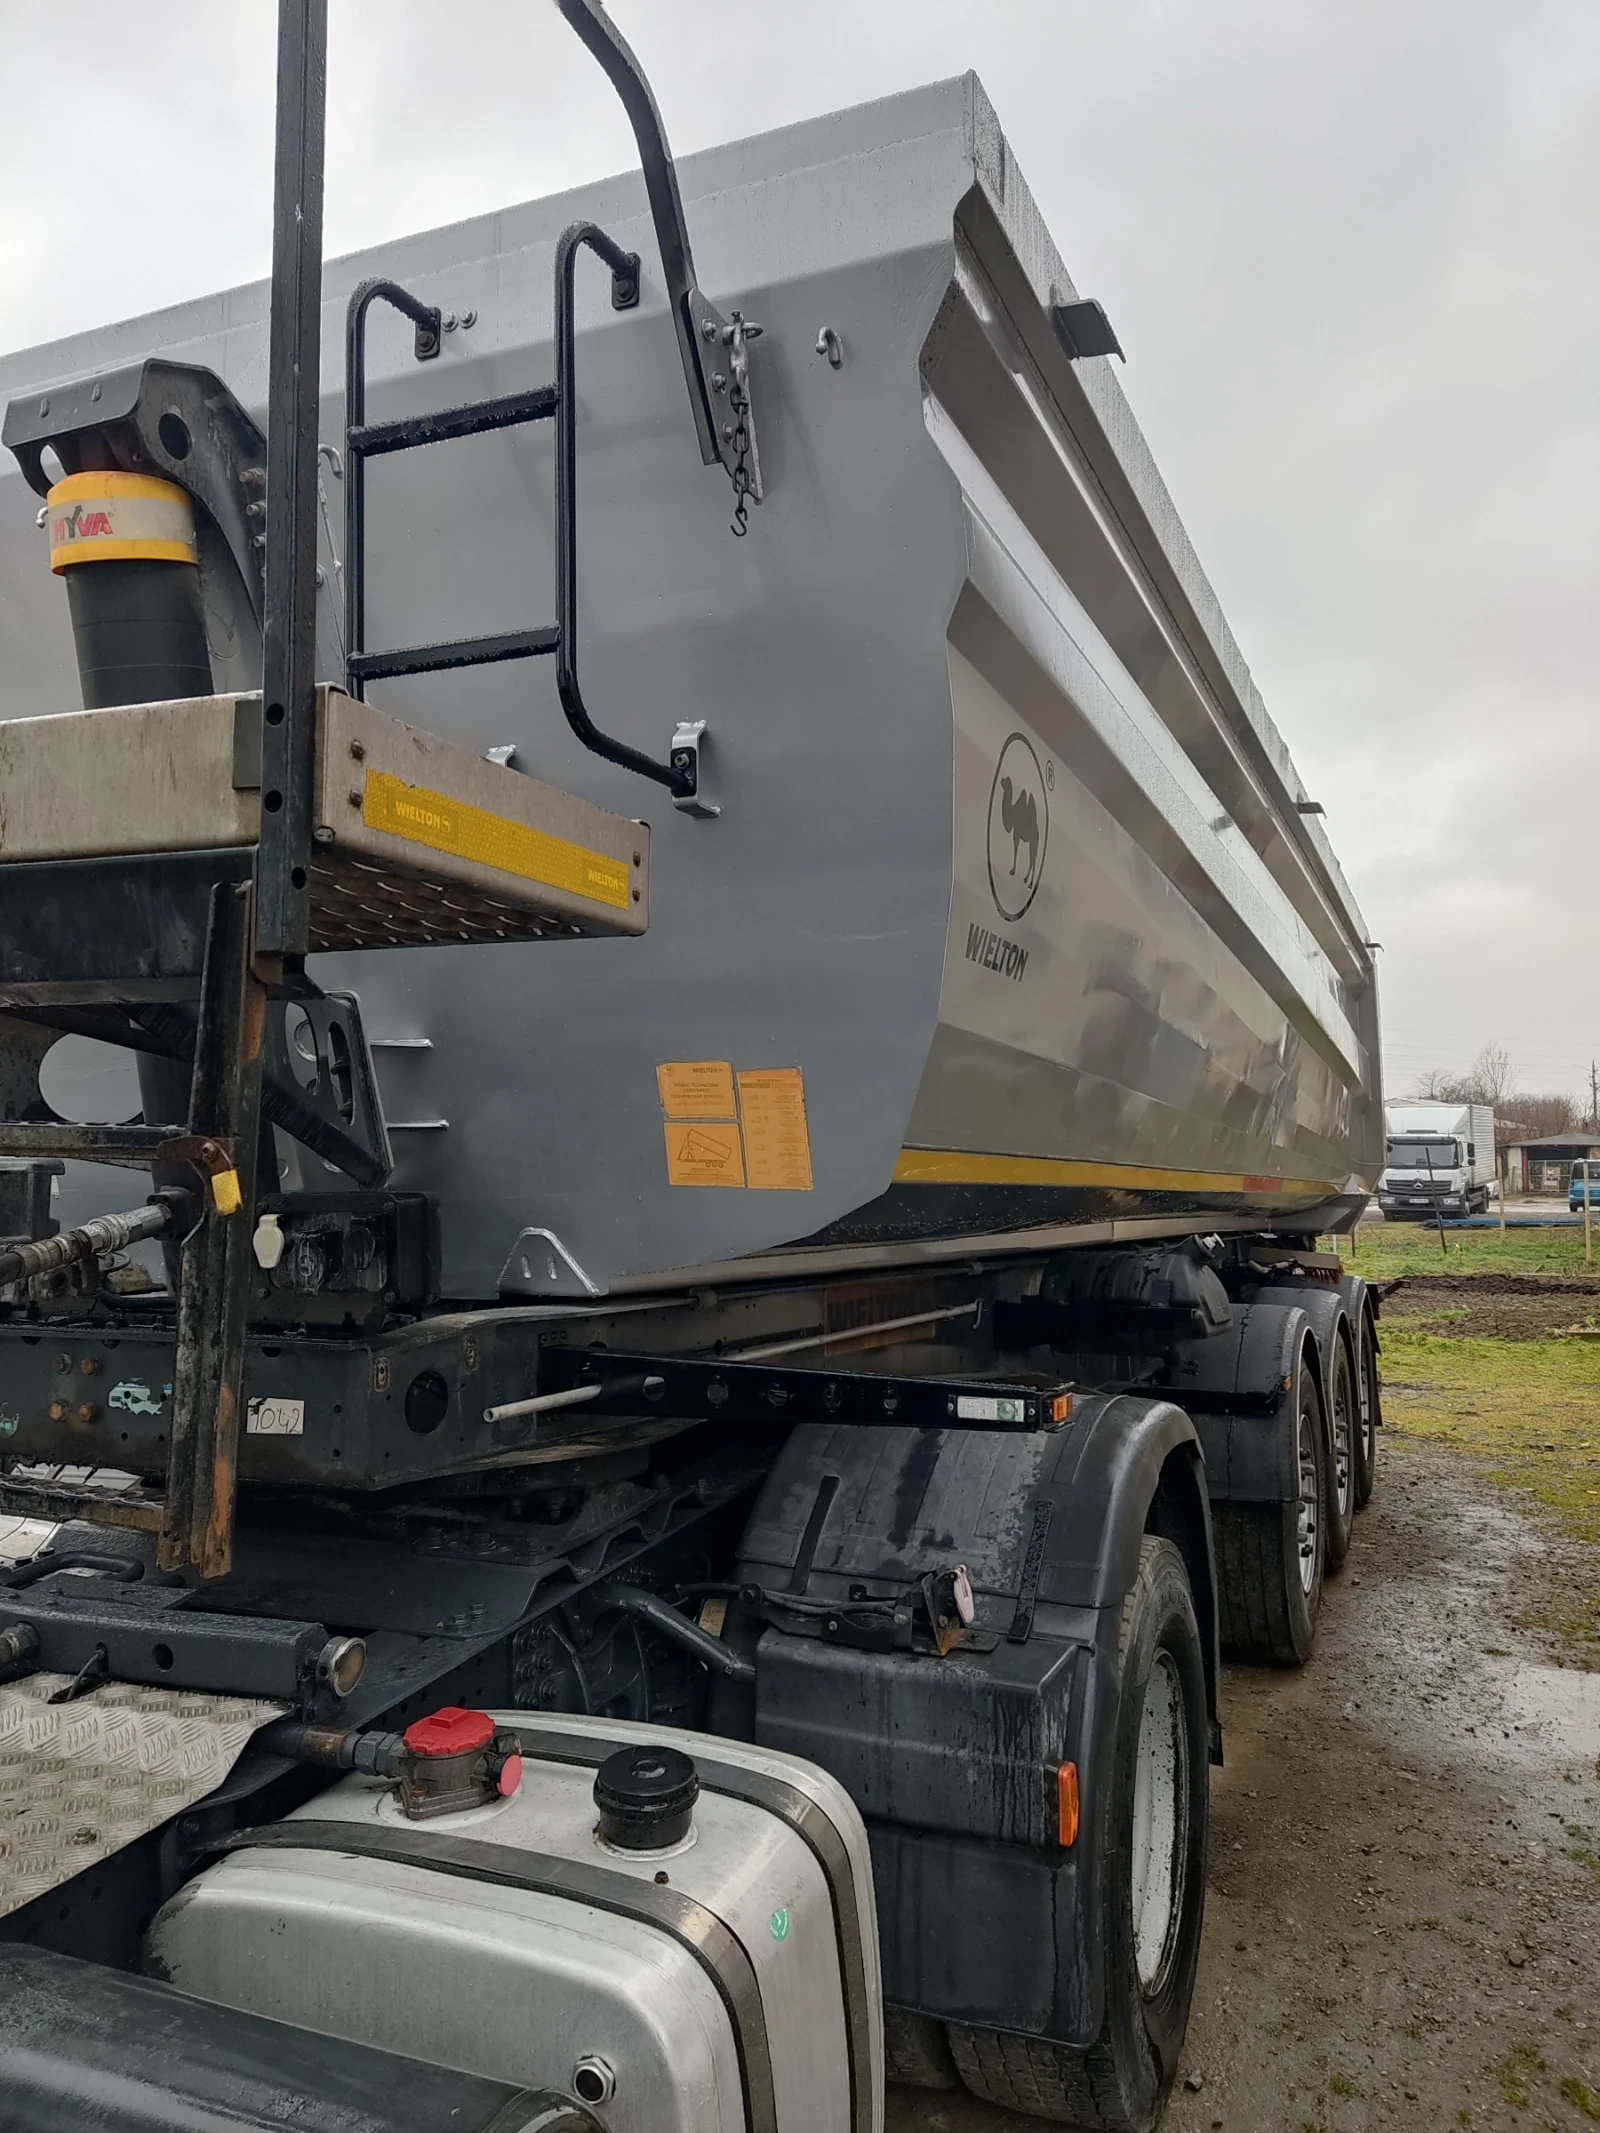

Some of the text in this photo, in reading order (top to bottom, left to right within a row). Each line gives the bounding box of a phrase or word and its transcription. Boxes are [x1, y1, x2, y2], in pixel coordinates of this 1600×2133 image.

[53, 505, 113, 542] HYVA
[396, 800, 440, 828] WIELTON
[588, 869, 619, 890] WIELTON
[965, 922, 1029, 982] WIELTON
